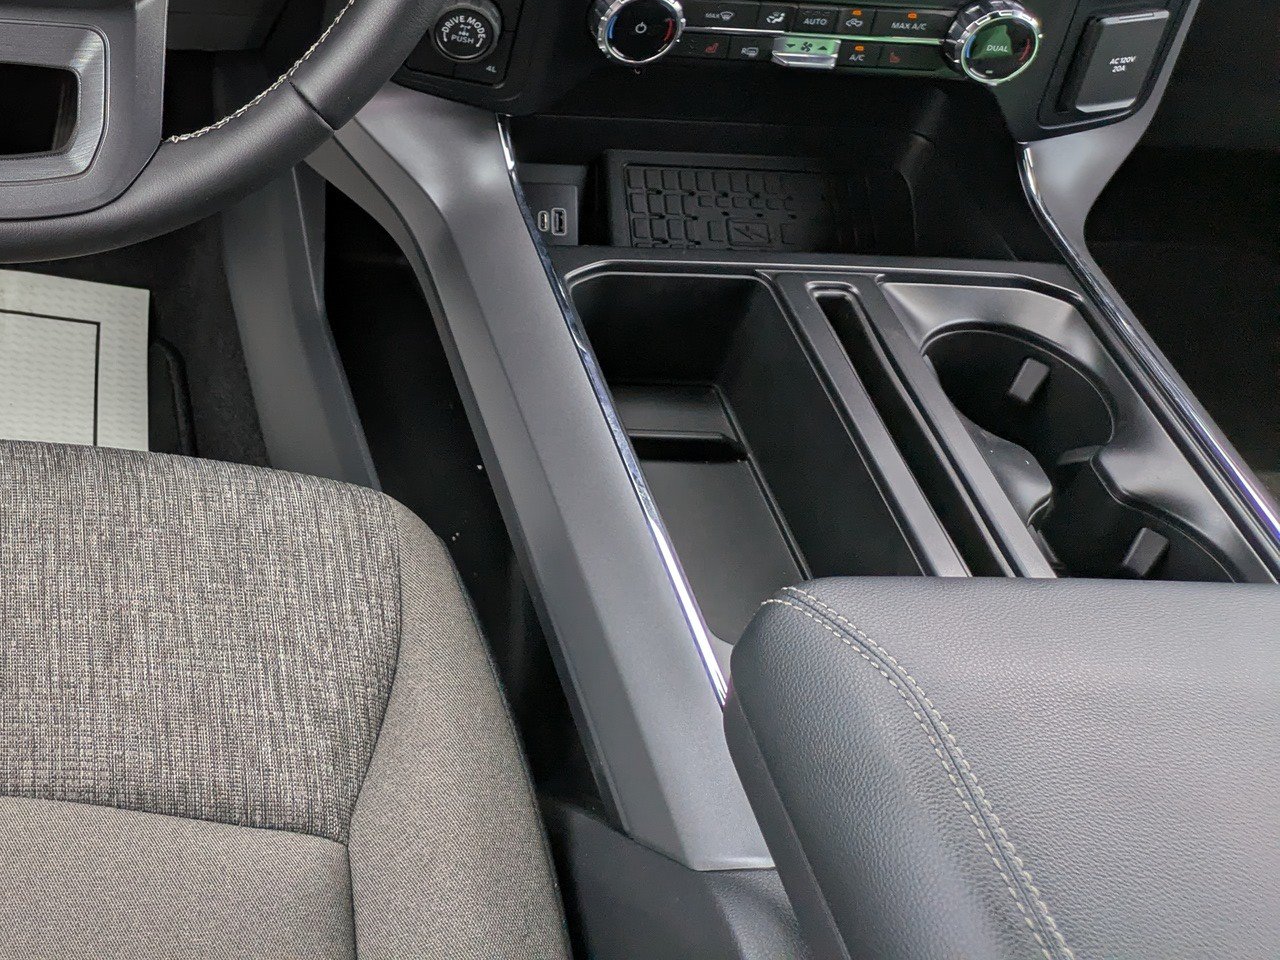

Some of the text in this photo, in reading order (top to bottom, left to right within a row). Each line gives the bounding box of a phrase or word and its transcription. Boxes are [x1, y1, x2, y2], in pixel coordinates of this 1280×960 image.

[803, 17, 828, 26] AUTO
[441, 15, 487, 39] DRIVE MODE
[891, 22, 928, 31] MAX A/C
[450, 34, 475, 44] PUSH
[985, 44, 1009, 53] DUAL
[848, 53, 866, 62] A/C
[1109, 55, 1137, 65] AC 120V
[486, 65, 498, 73] 4L
[1111, 65, 1126, 73] 20A
